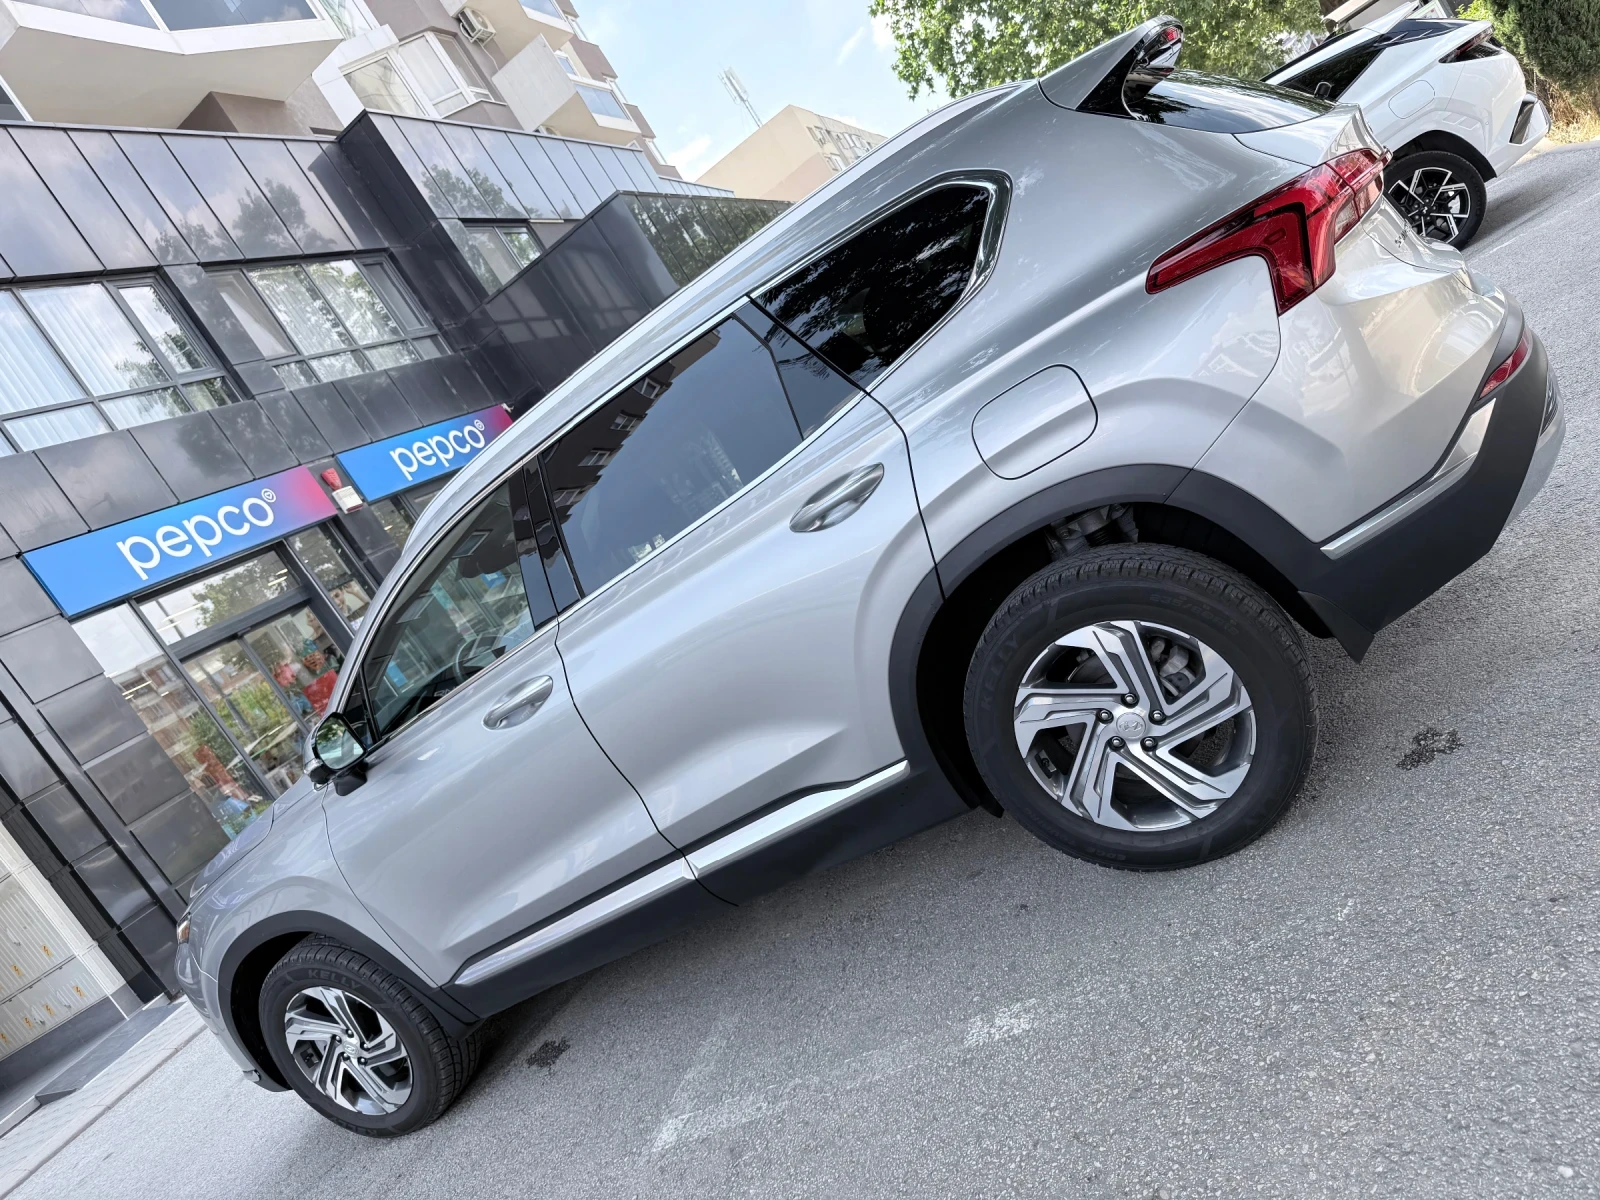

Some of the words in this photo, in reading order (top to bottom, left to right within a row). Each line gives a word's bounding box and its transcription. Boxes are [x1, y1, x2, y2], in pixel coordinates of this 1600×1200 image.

[389, 424, 485, 482] pepco
[116, 496, 275, 581] pepco
[308, 968, 364, 990] KELLY
